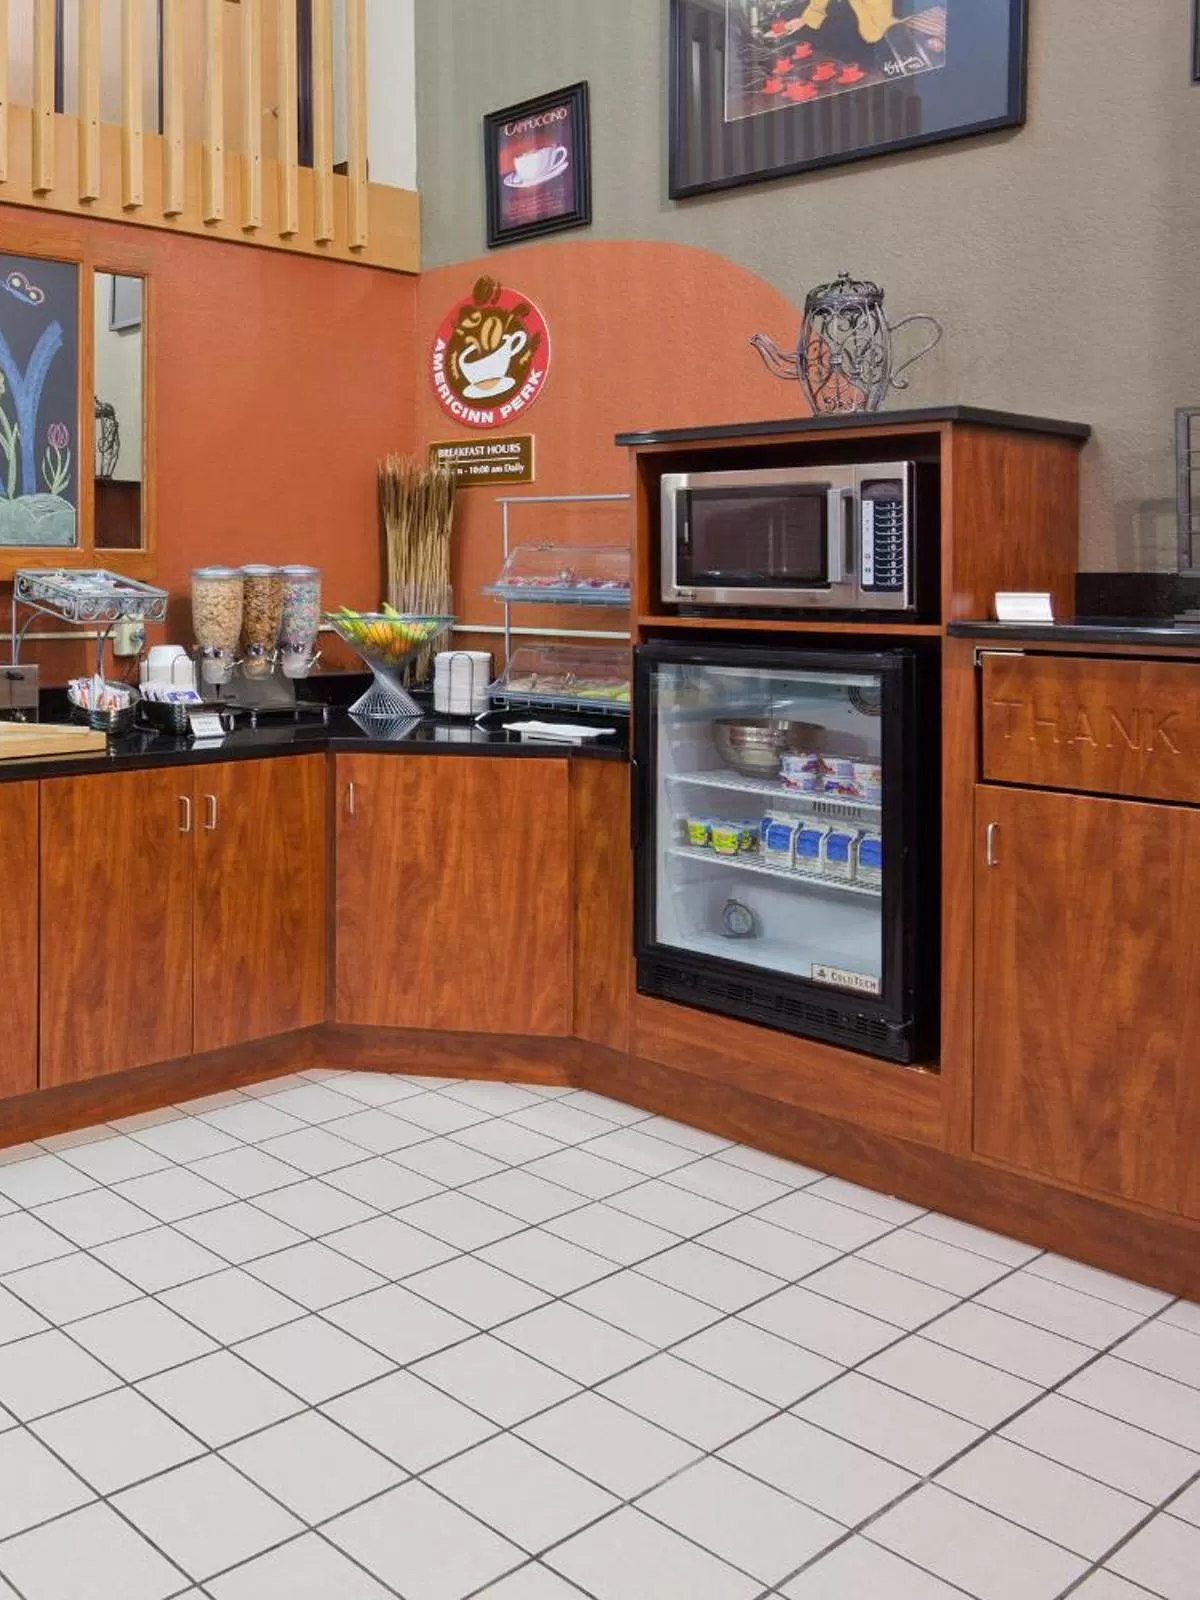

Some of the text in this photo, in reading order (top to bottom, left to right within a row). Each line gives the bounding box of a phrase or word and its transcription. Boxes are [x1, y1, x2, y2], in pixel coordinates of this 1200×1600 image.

[503, 107, 568, 137] CAPPUCCINO
[433, 337, 543, 424] AMERICINN PERK
[438, 442, 521, 458] BREAKFAST HOURS
[504, 462, 525, 475] Daily
[992, 700, 1182, 754] THANK
